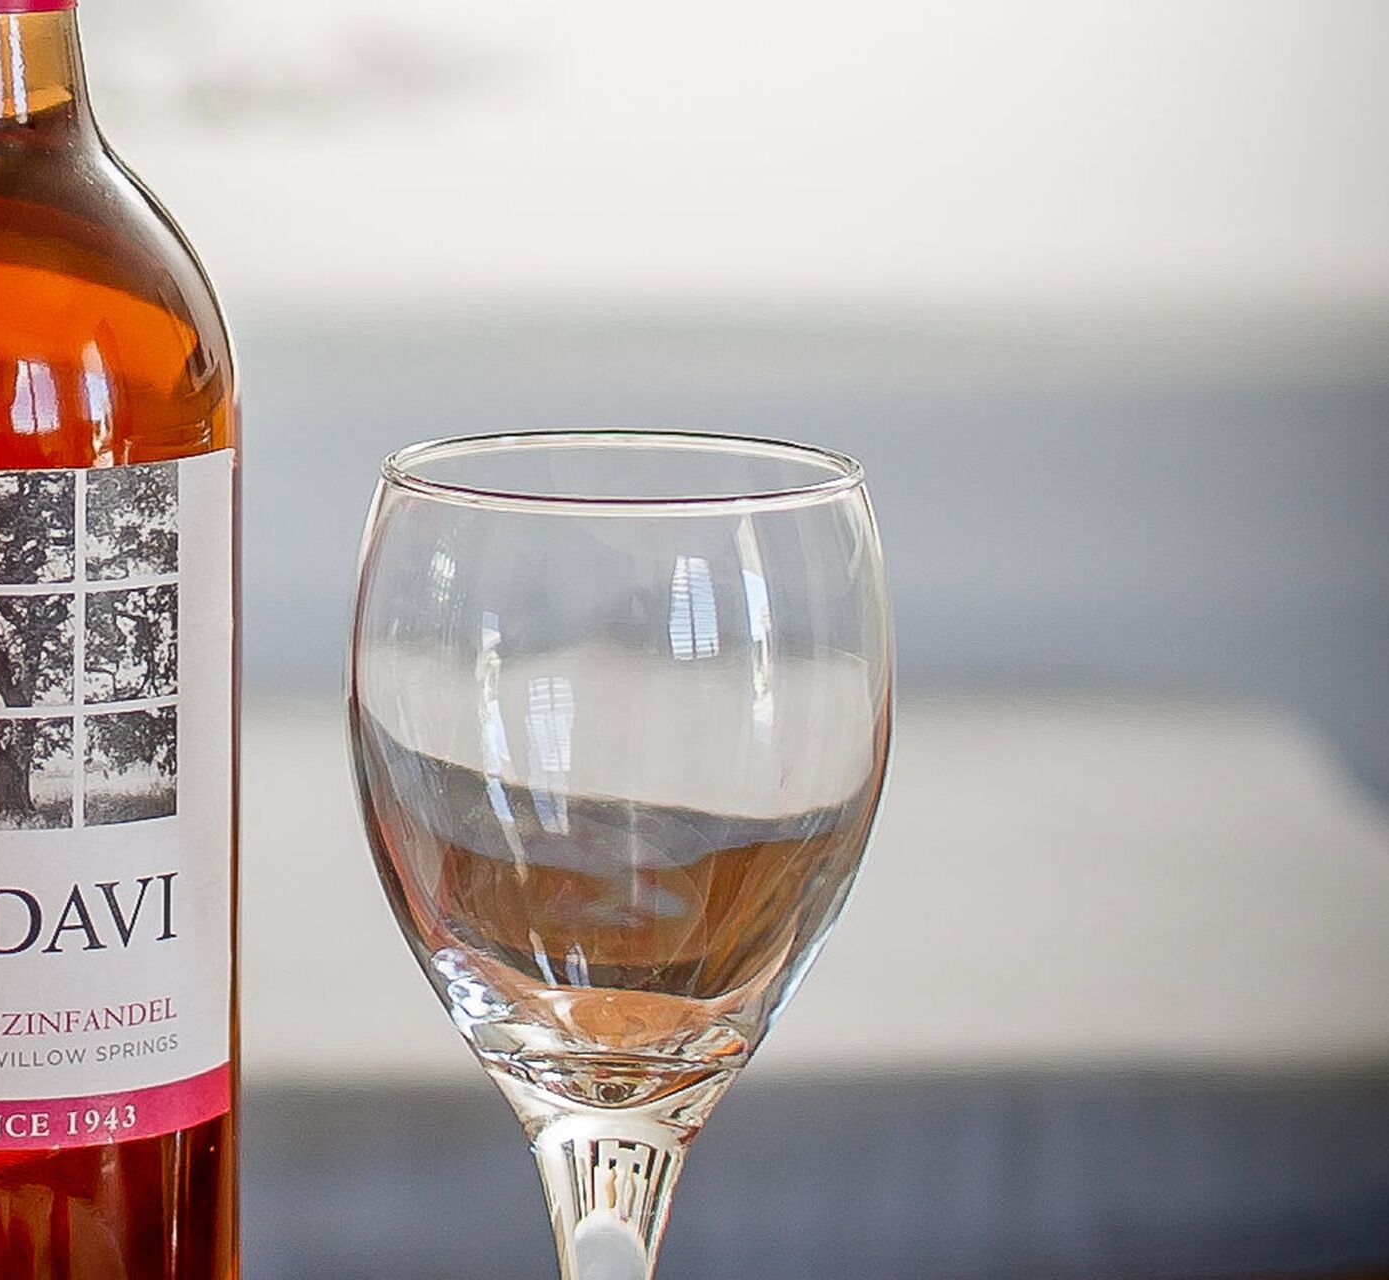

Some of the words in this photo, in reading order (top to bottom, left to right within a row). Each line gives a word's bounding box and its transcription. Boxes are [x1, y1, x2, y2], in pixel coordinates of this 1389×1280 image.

[1, 996, 178, 1037] ZINFANDEL
[95, 1033, 179, 1063] SPRINGS
[66, 1103, 137, 1135] 1943
